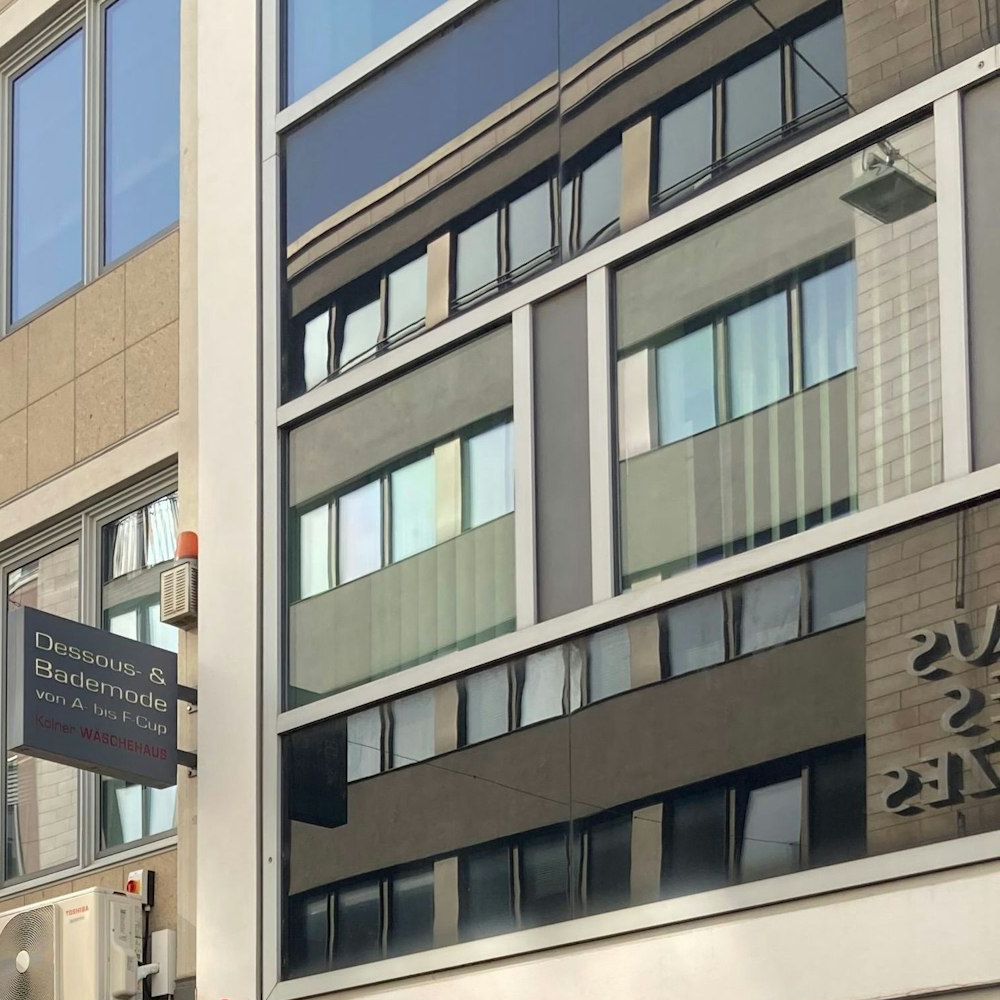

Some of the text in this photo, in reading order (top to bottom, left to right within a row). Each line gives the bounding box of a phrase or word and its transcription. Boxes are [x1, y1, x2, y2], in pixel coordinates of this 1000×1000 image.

[35, 631, 167, 686] Dessous- &
[35, 658, 168, 713] Bademode
[35, 689, 168, 736] von A- bis F-Cup
[65, 904, 90, 917] TOSHIBA
